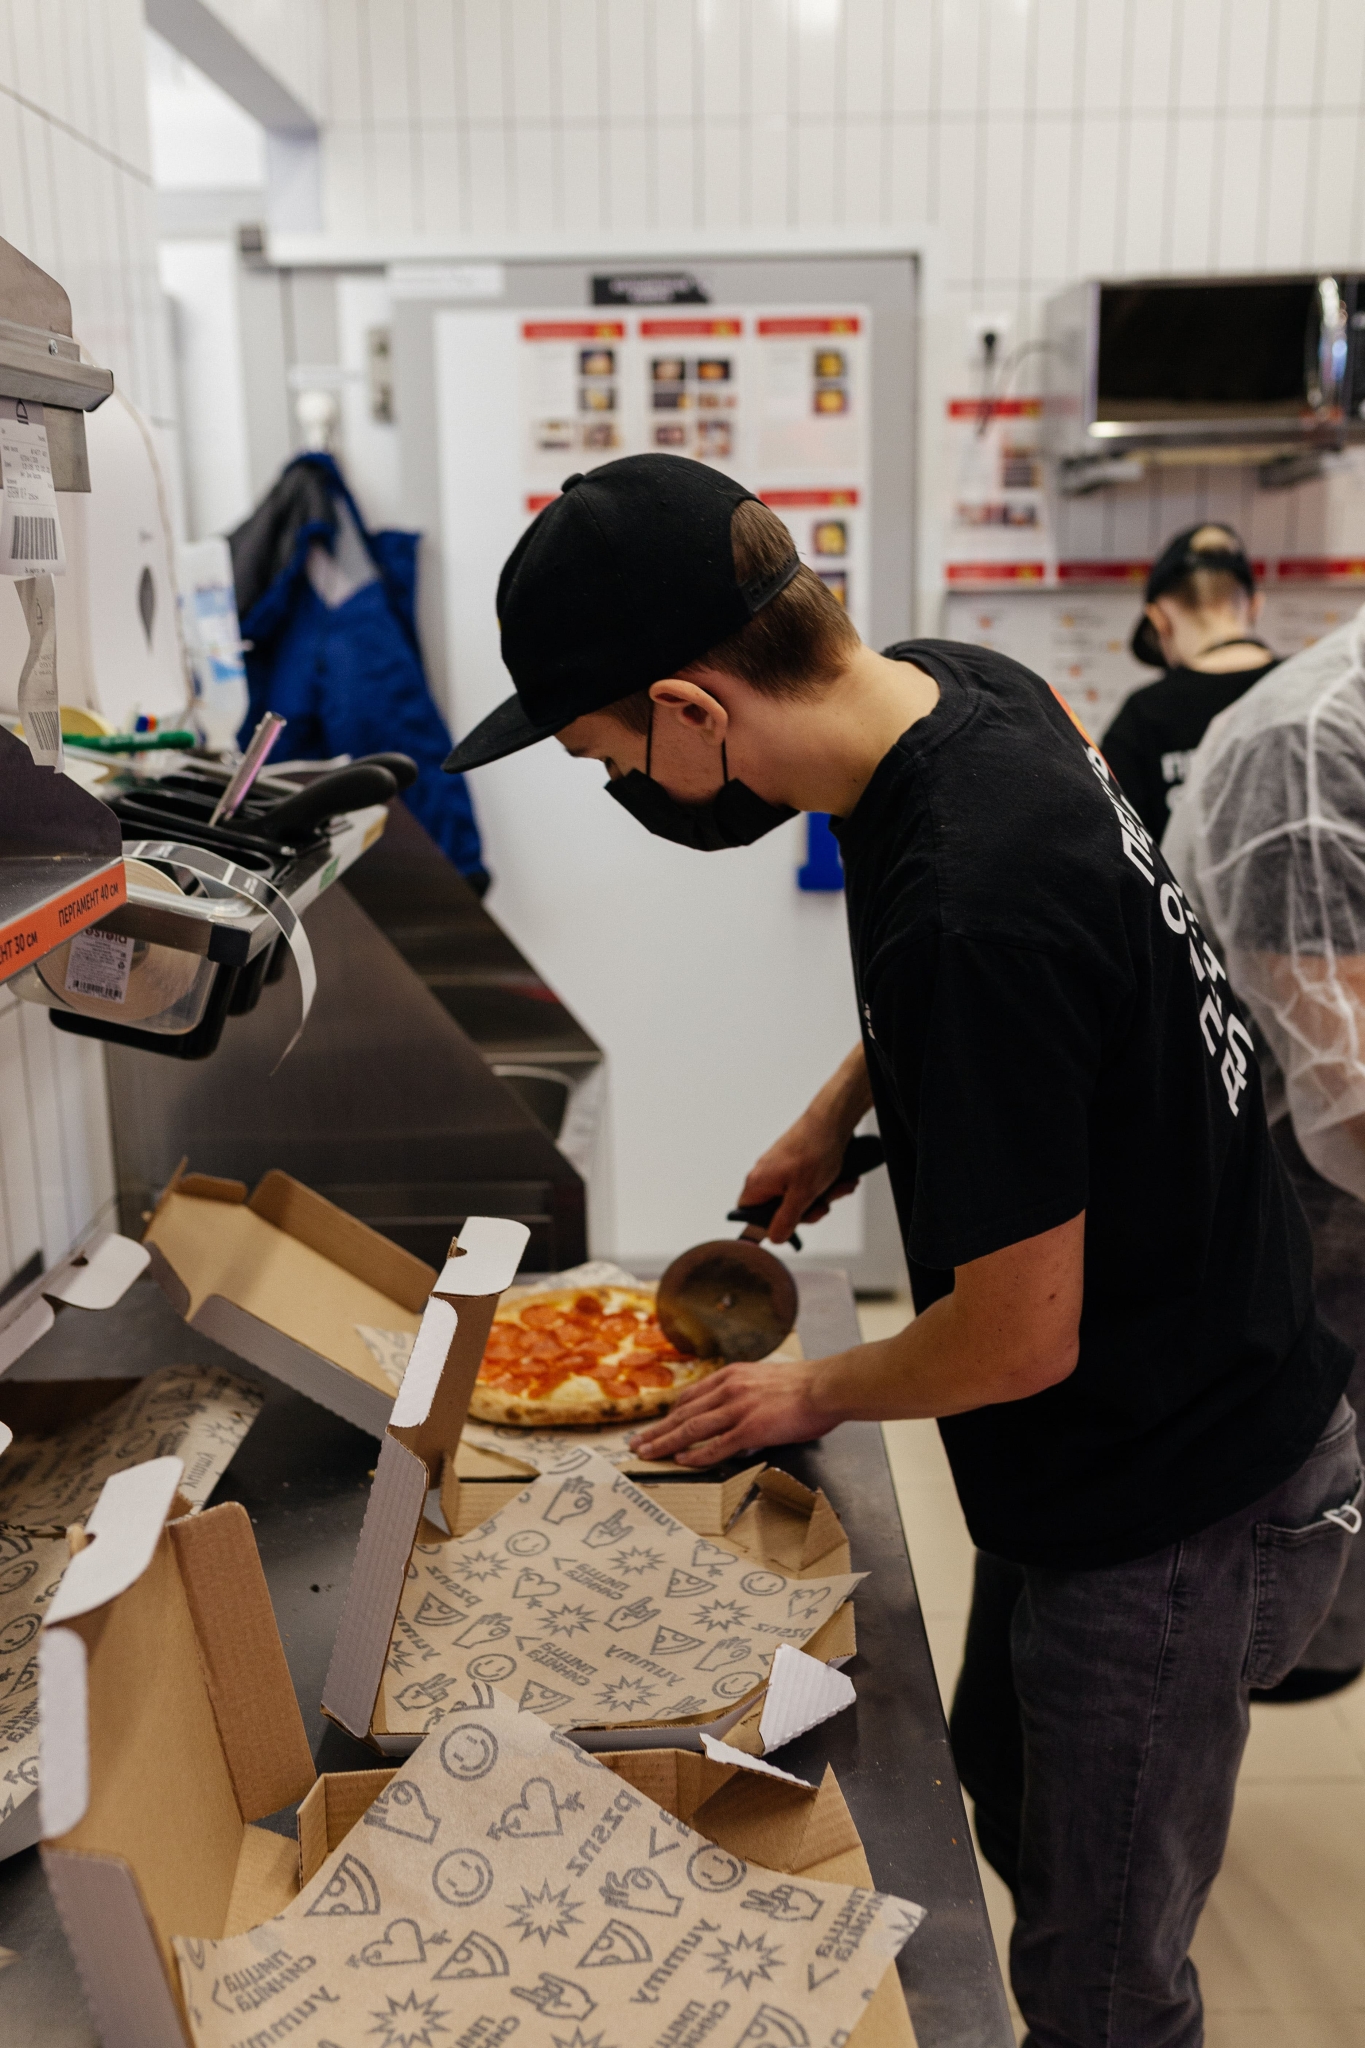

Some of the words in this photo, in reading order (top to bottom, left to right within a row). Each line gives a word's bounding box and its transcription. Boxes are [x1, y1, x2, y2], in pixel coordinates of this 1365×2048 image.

[58, 888, 99, 928] ПЕРГАМЕНТ
[101, 883, 109, 902] 40
[14, 932, 25, 955] 30
